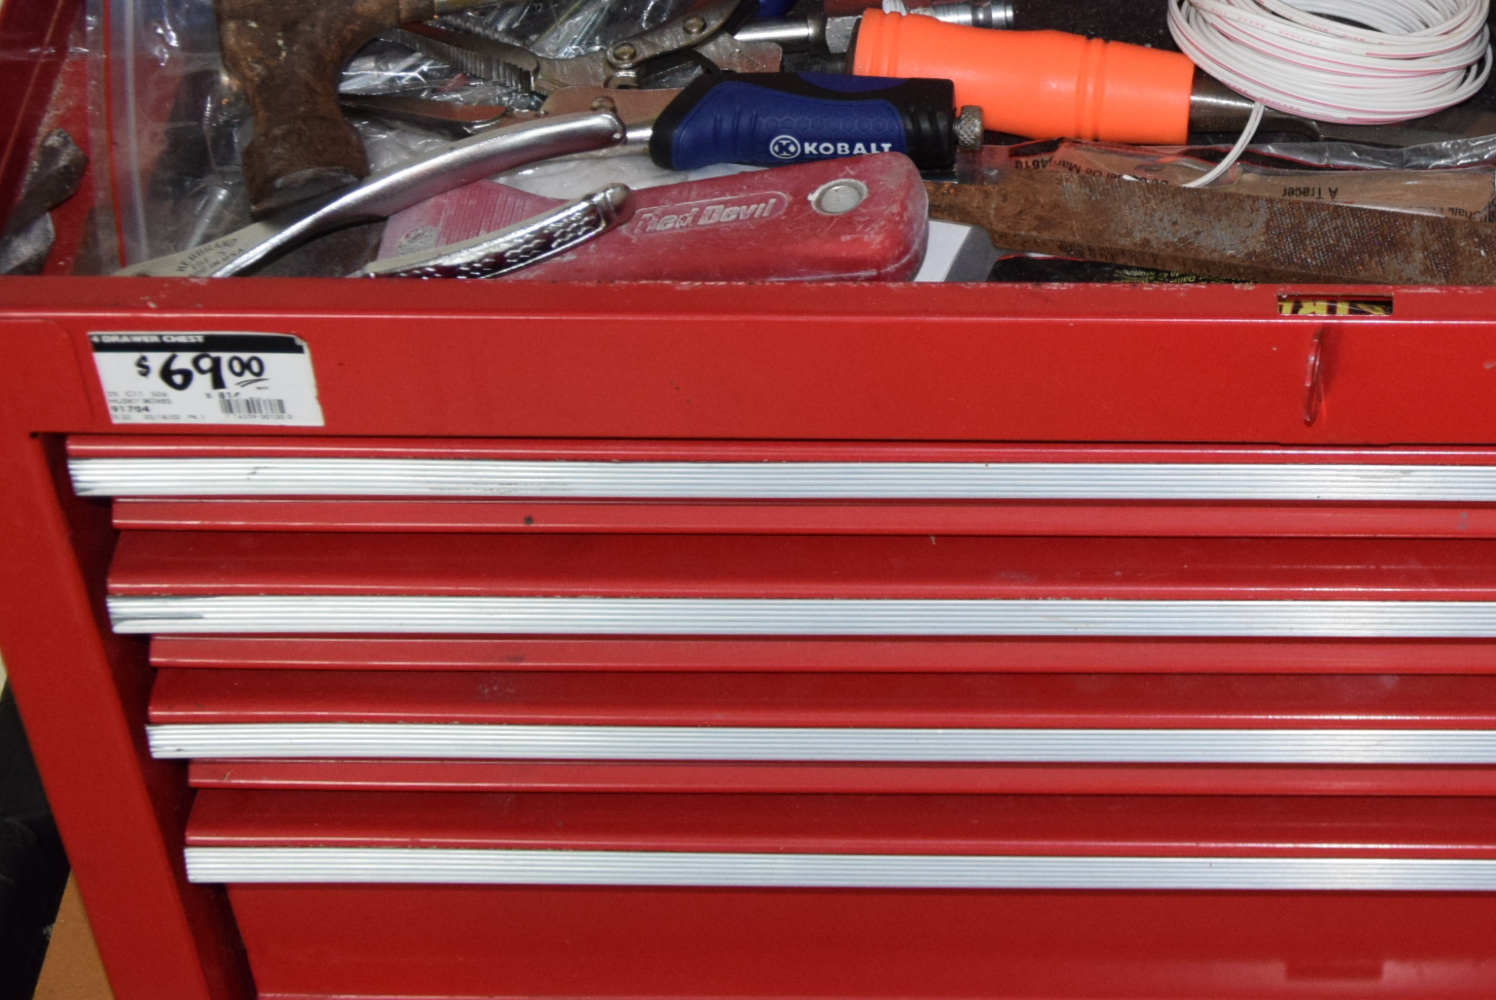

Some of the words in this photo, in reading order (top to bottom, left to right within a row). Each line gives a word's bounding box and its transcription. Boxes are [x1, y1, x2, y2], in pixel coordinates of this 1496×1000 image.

[804, 142, 893, 155] KOBALT
[1281, 186, 1324, 200] Tracer
[699, 198, 778, 226] Devil
[101, 334, 161, 344] DRAWER
[162, 334, 204, 344] CHEST
